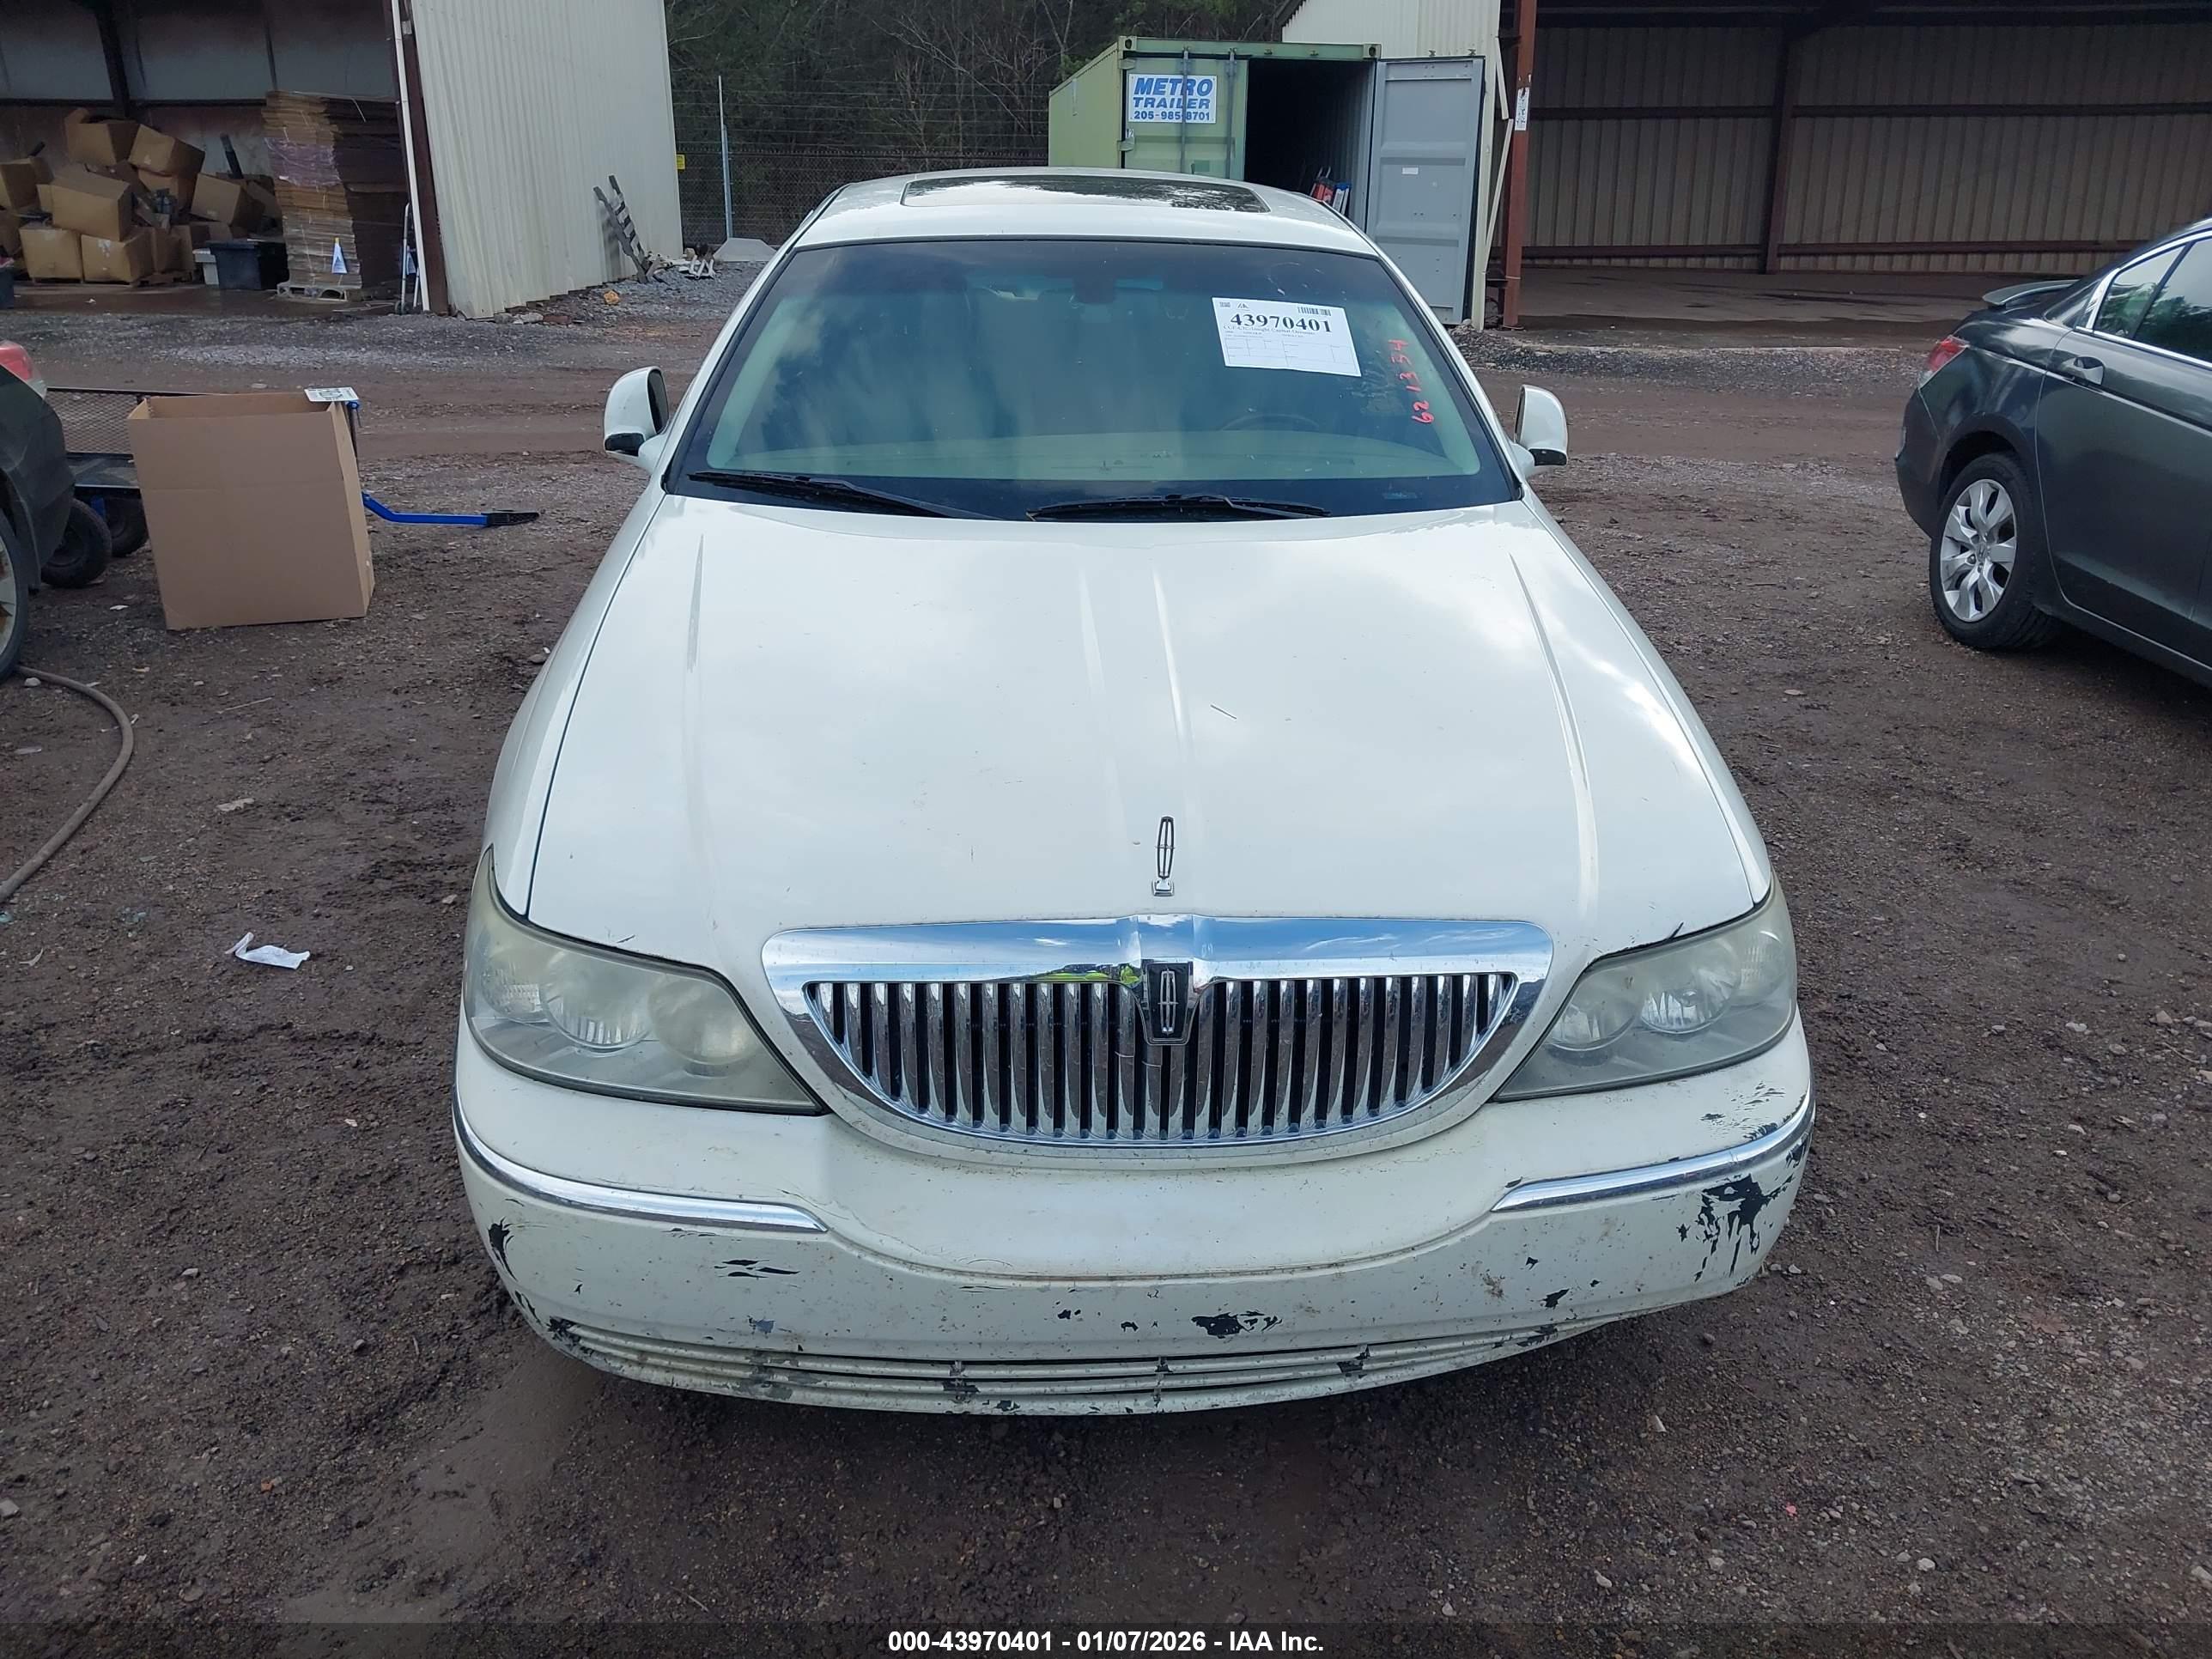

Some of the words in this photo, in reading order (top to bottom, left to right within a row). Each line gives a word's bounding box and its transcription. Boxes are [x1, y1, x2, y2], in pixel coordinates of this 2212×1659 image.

[1133, 77, 1213, 97] METRO
[1133, 97, 1211, 109] TRAILER
[1133, 111, 1210, 121] 205-9858701
[1230, 313, 1333, 333] 43970401
